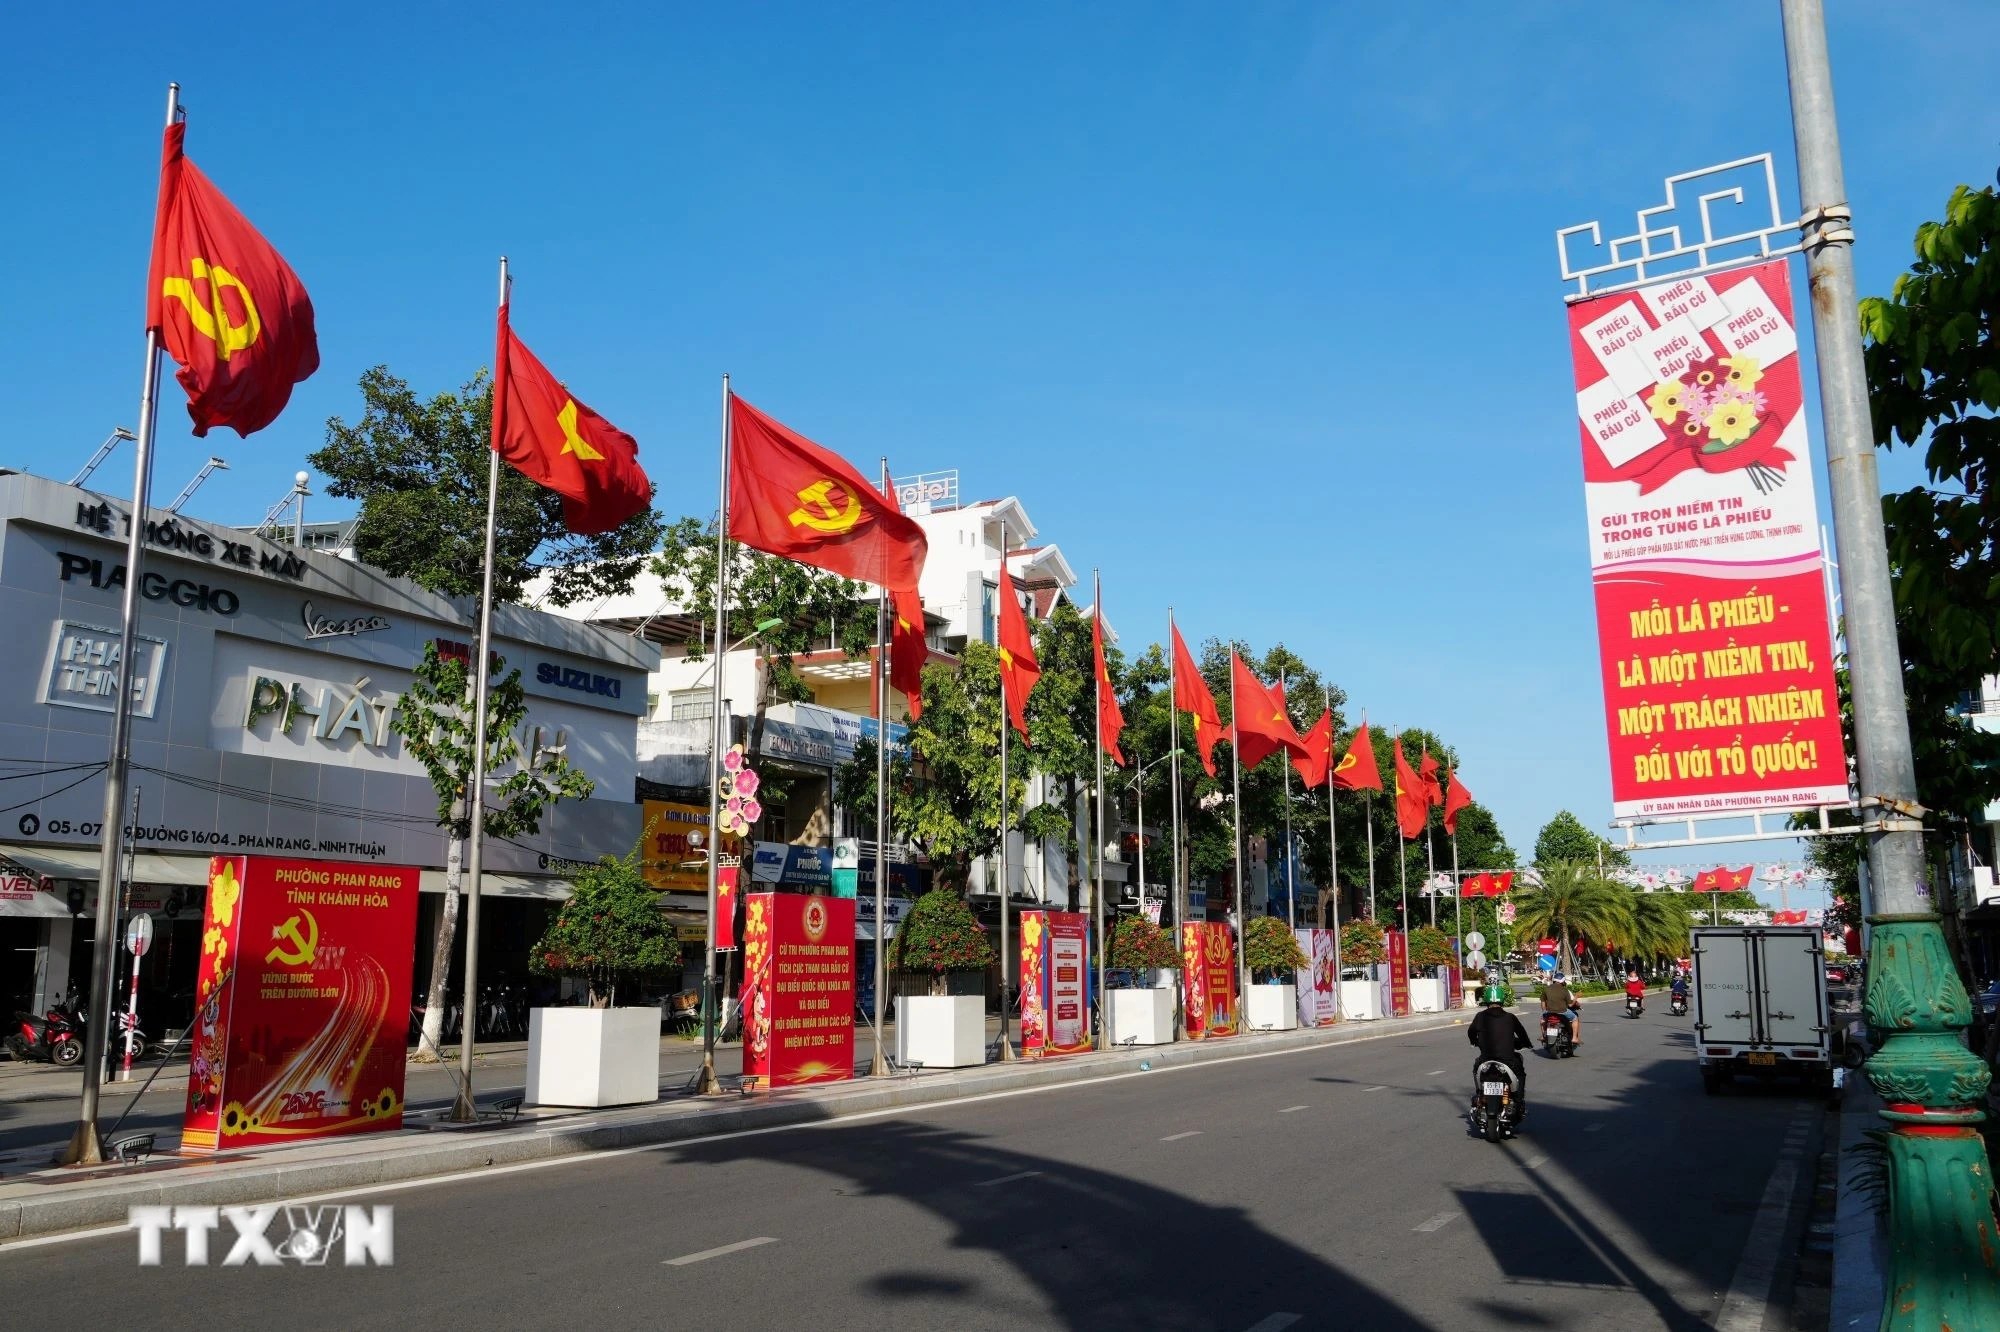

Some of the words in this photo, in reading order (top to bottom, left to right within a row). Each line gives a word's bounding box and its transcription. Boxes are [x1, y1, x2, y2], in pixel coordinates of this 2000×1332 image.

[1657, 279, 1693, 306] PHIẾU
[1596, 314, 1630, 340] PHIẾU
[1727, 306, 1764, 333] PHIẾU
[1653, 335, 1689, 361] PHIẾU
[1593, 399, 1628, 424] PHIẾU
[1601, 512, 1627, 528] GỬI
[1631, 507, 1672, 524] TRỌN
[1676, 498, 1714, 517] NIỀM
[1718, 496, 1743, 511] TIN
[1602, 526, 1653, 543] TRONG
[1703, 513, 1721, 529] LÁ
[1726, 505, 1772, 527] PHIẾU
[76, 501, 112, 533] HỆ
[220, 540, 253, 565] XE
[260, 550, 306, 578] MÁY
[57, 551, 240, 615] PIAGGIO
[302, 600, 391, 640] Vespa
[1630, 598, 1672, 639] MỖI
[1676, 598, 1705, 633] LÁ
[1709, 586, 1774, 630] PHIẾU
[1617, 654, 1646, 688] LÀ
[1649, 648, 1698, 687] MỘT
[1702, 637, 1764, 679] NIỀM
[1766, 640, 1815, 673] TIN,
[537, 662, 621, 699] SUZUKI
[242, 676, 398, 747] PHÁT
[1618, 700, 1666, 740] MỘT
[1669, 694, 1743, 731] TRÁCH
[1746, 684, 1825, 726] NHIỆM
[1634, 742, 1672, 784] ĐỐI
[1675, 743, 1713, 780] VỚI
[1716, 734, 1747, 777] TỔ
[1751, 731, 1818, 780] QUỐC!
[1657, 801, 1675, 812] BAN
[1677, 798, 1701, 810] NHÂN
[1704, 796, 1723, 808] DÂN
[1725, 794, 1762, 807] PHƯỜNG
[1764, 795, 1790, 805] PHAN
[1792, 793, 1818, 802] RANG
[132, 825, 189, 842] ĐƯỜNG
[191, 830, 229, 846] 16/04
[238, 834, 275, 848] PHAN
[275, 838, 311, 850] RANG
[318, 840, 350, 854] NINH
[348, 841, 386, 860] THUẬN
[275, 868, 330, 885] PHƯỜNG
[333, 873, 366, 887] PHAN
[369, 875, 402, 889] RANG
[287, 887, 315, 904] TỈNH
[319, 889, 361, 906] KHÁNH
[363, 892, 389, 907] HÒA
[312, 946, 346, 970] XIV
[805, 963, 820, 974] THAM
[821, 963, 830, 974] GIA
[260, 987, 286, 999] TRÊN
[280, 1090, 326, 1116] 2026
